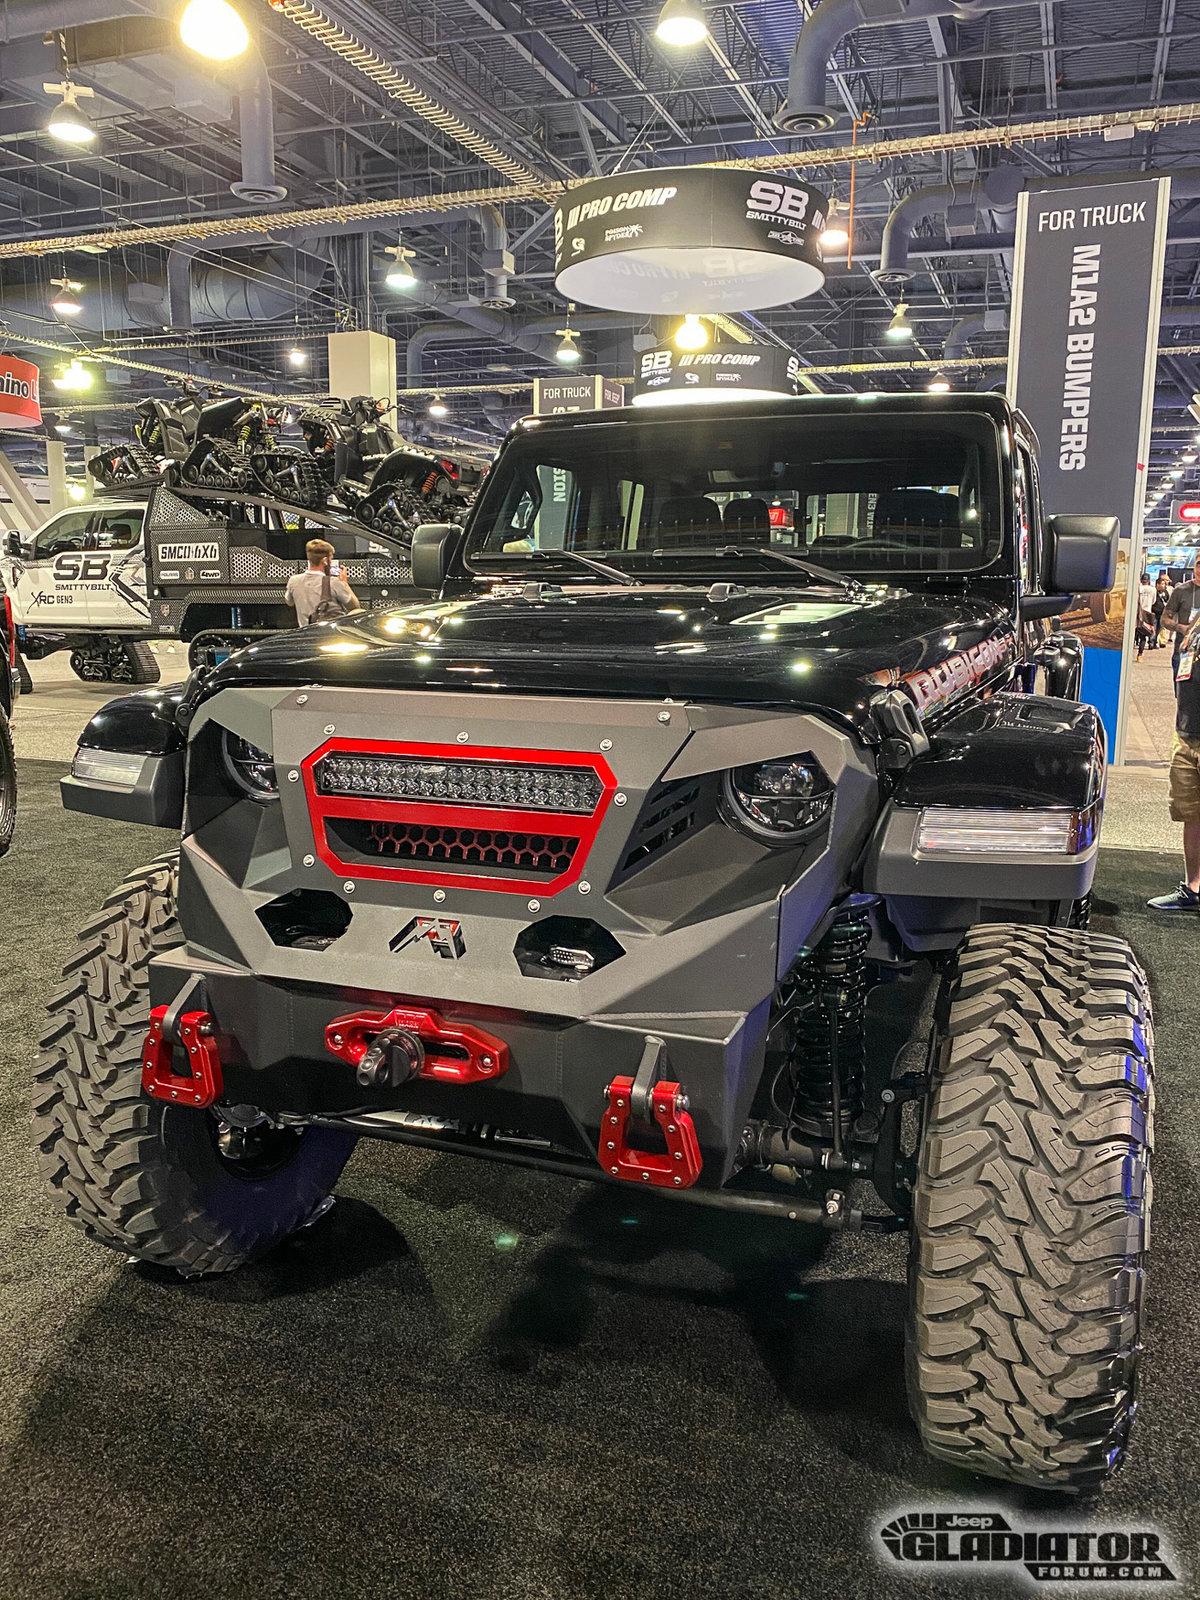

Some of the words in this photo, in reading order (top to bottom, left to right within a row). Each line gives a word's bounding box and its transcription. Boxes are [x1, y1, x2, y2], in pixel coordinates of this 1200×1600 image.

[579, 195, 613, 223] PRO
[612, 186, 678, 212] COMP
[746, 180, 809, 220] SB
[745, 210, 807, 231] SMITTYBILT
[1038, 208, 1075, 233] FOR
[1080, 201, 1147, 228] TRUCK
[1068, 243, 1101, 327] M1A2
[641, 351, 672, 372] SB
[693, 353, 722, 365] PRO
[721, 353, 761, 366] COMP
[543, 388, 560, 399] FOR
[562, 386, 591, 398] TRUCK
[1058, 332, 1095, 472] BUMPERS
[53, 553, 111, 580] SB
[55, 583, 111, 591] SMITTYBILT
[27, 590, 55, 614] XRC
[56, 595, 74, 605] GEN3
